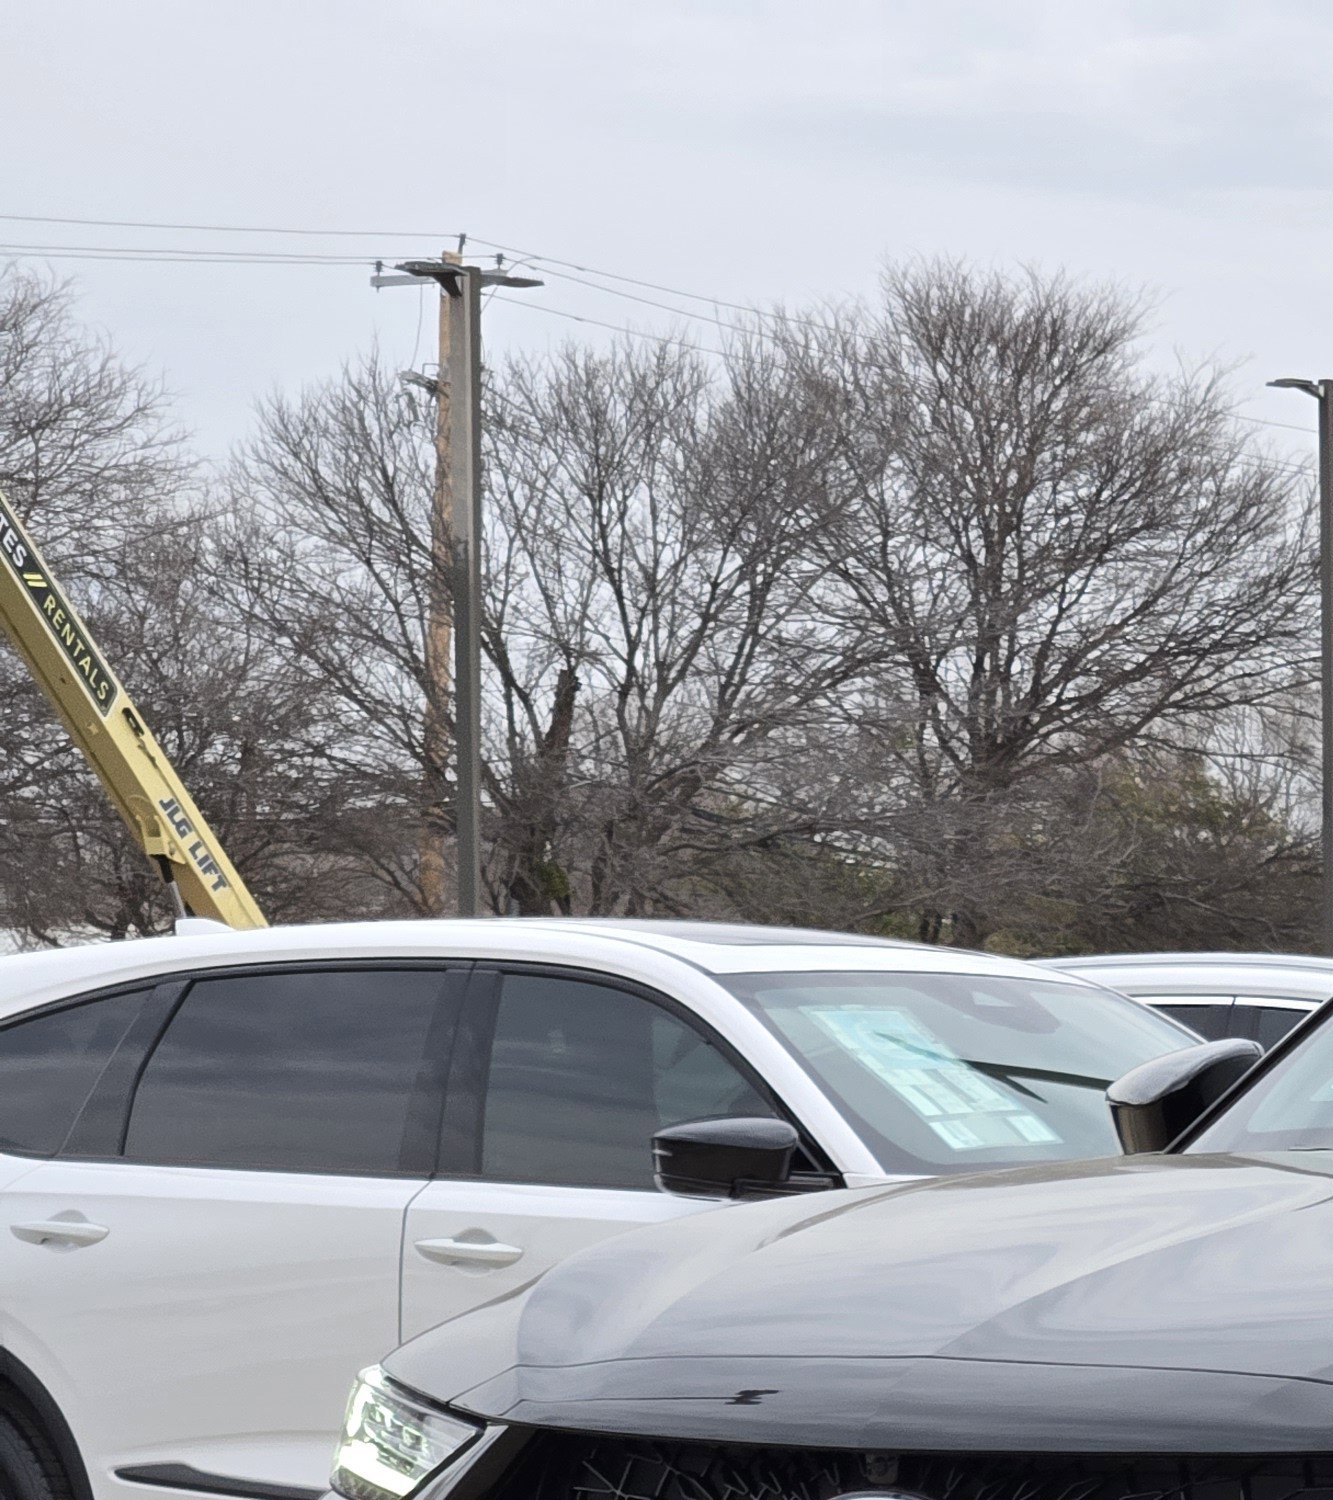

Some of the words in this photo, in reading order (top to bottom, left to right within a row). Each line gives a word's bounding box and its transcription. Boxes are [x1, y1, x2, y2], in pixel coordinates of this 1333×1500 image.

[44, 593, 109, 700] RENTALS
[158, 797, 193, 839] JLG
[188, 841, 228, 892] LIFT
